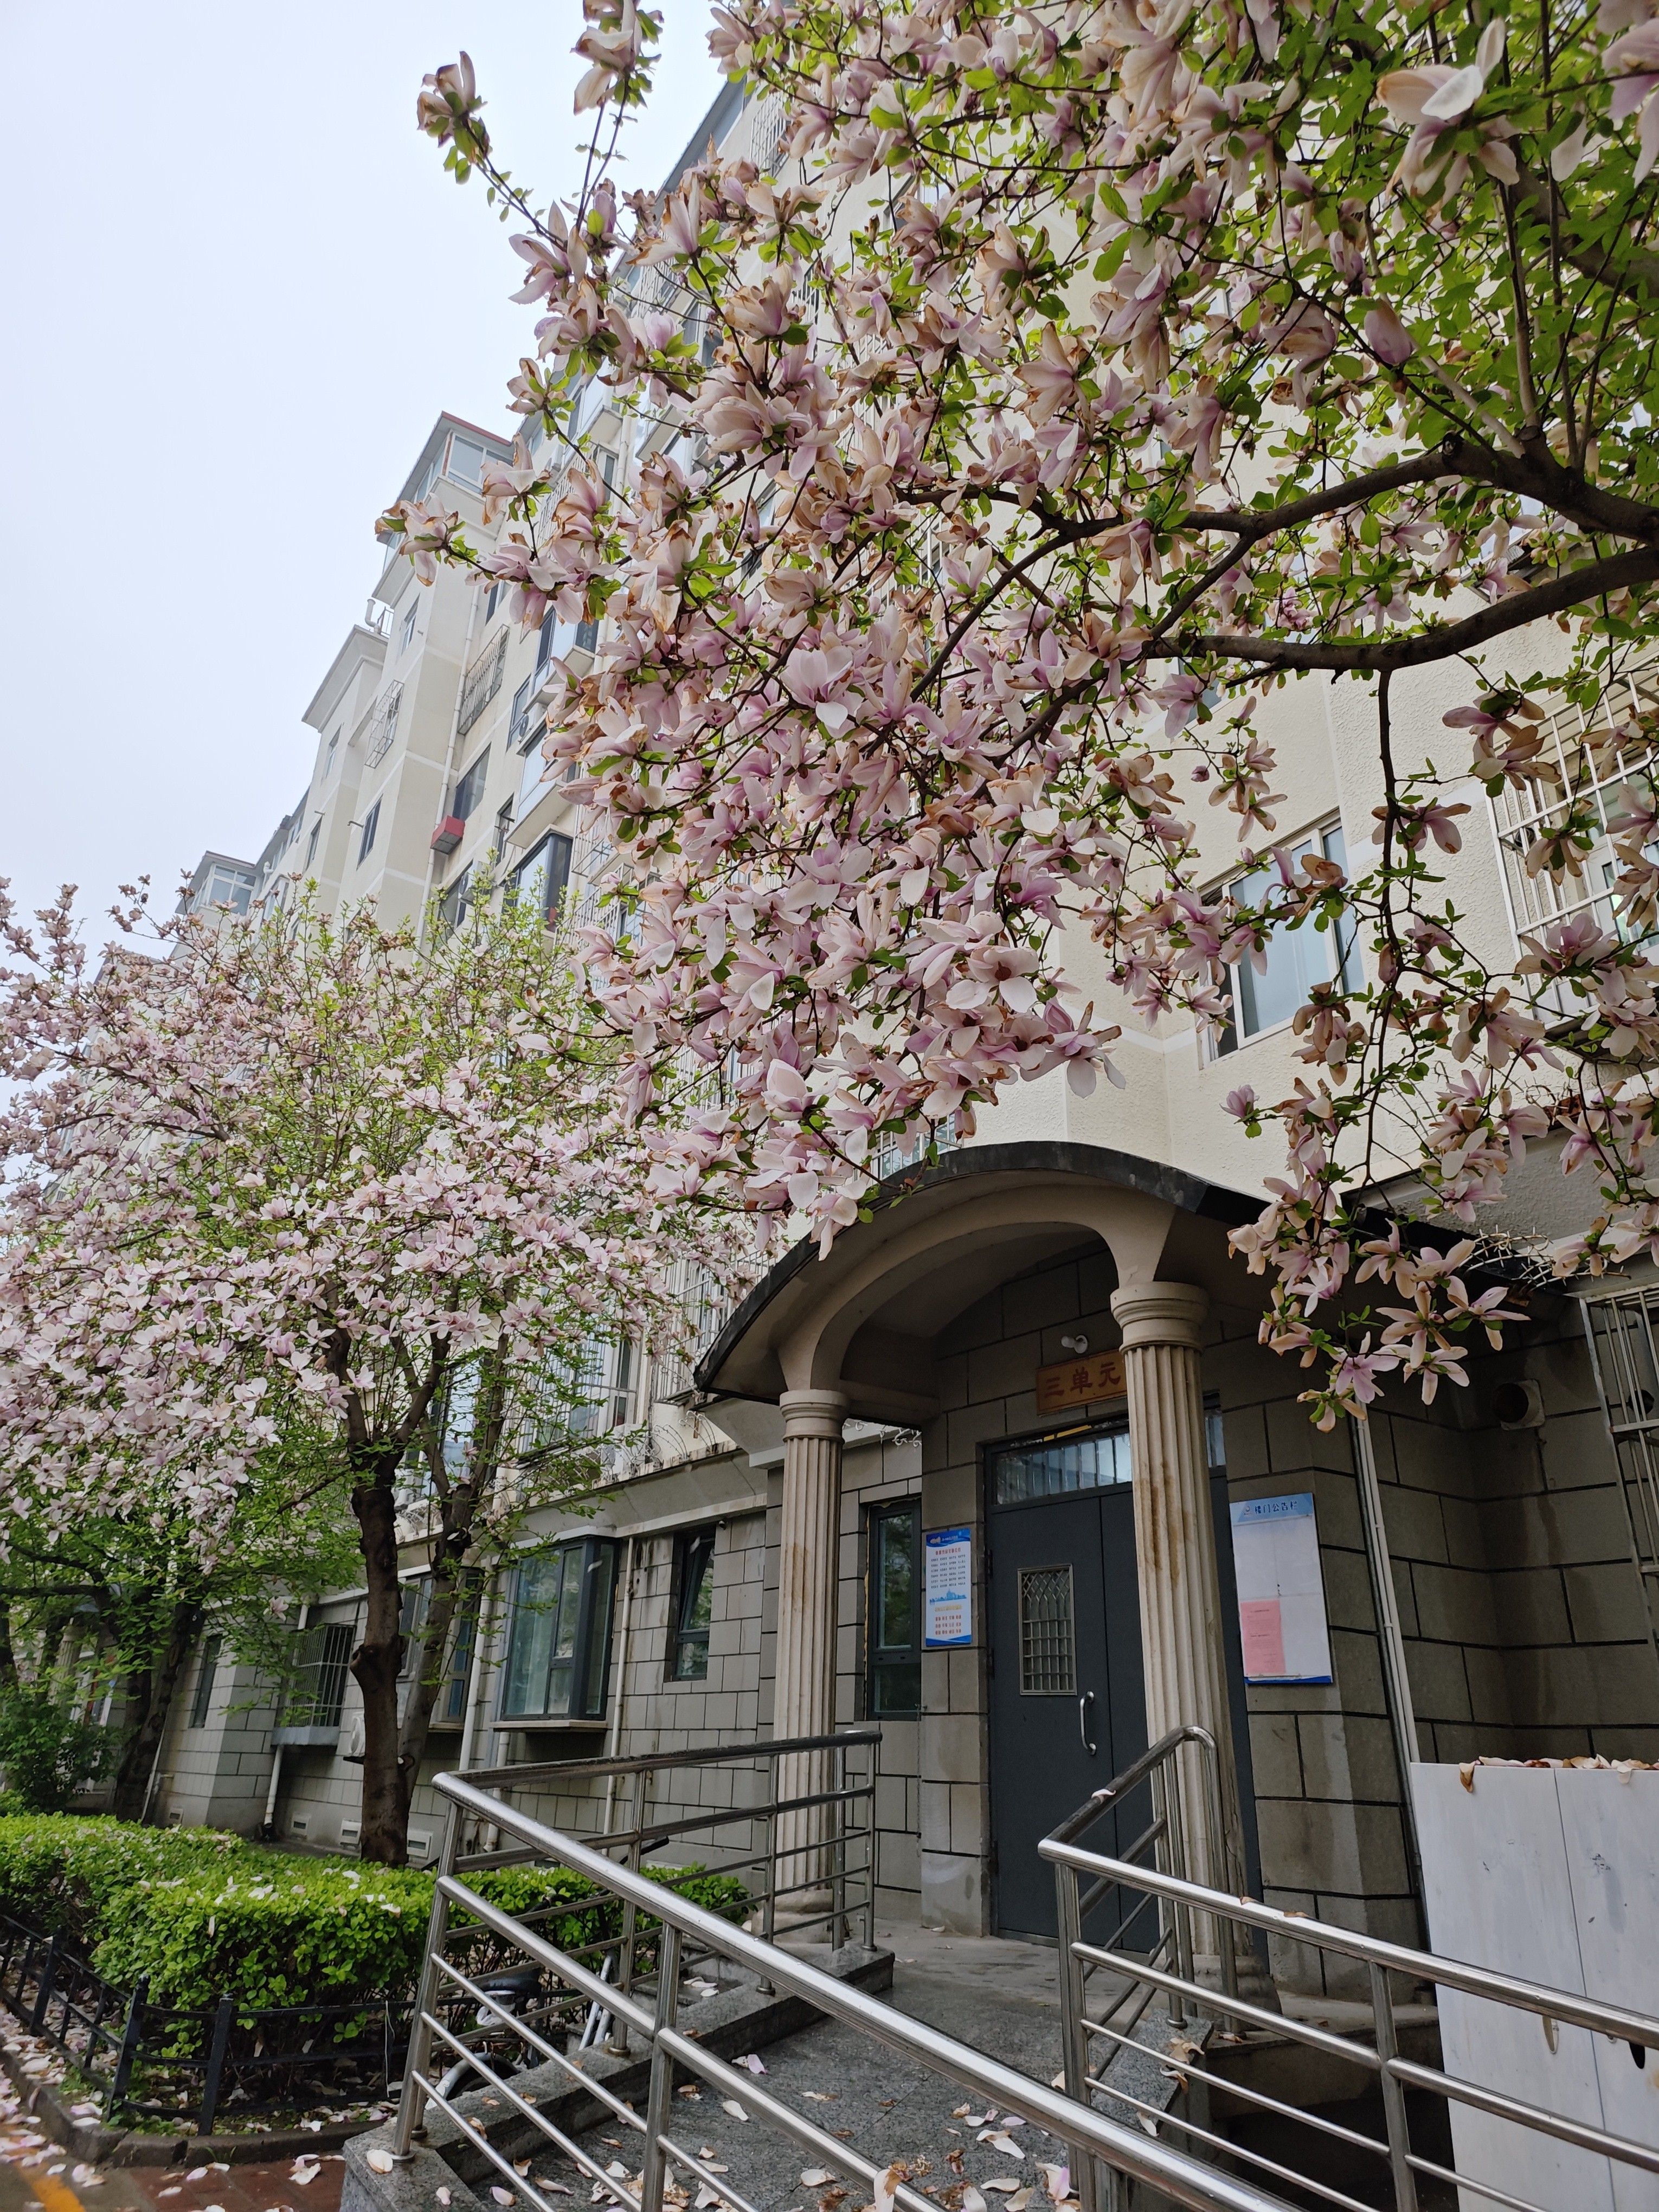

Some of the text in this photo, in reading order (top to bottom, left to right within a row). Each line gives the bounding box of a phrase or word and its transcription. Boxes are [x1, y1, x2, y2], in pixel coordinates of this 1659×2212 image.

[1044, 1362, 1121, 1398] 三单元
[1255, 1501, 1297, 1514] 楼门公告栏
